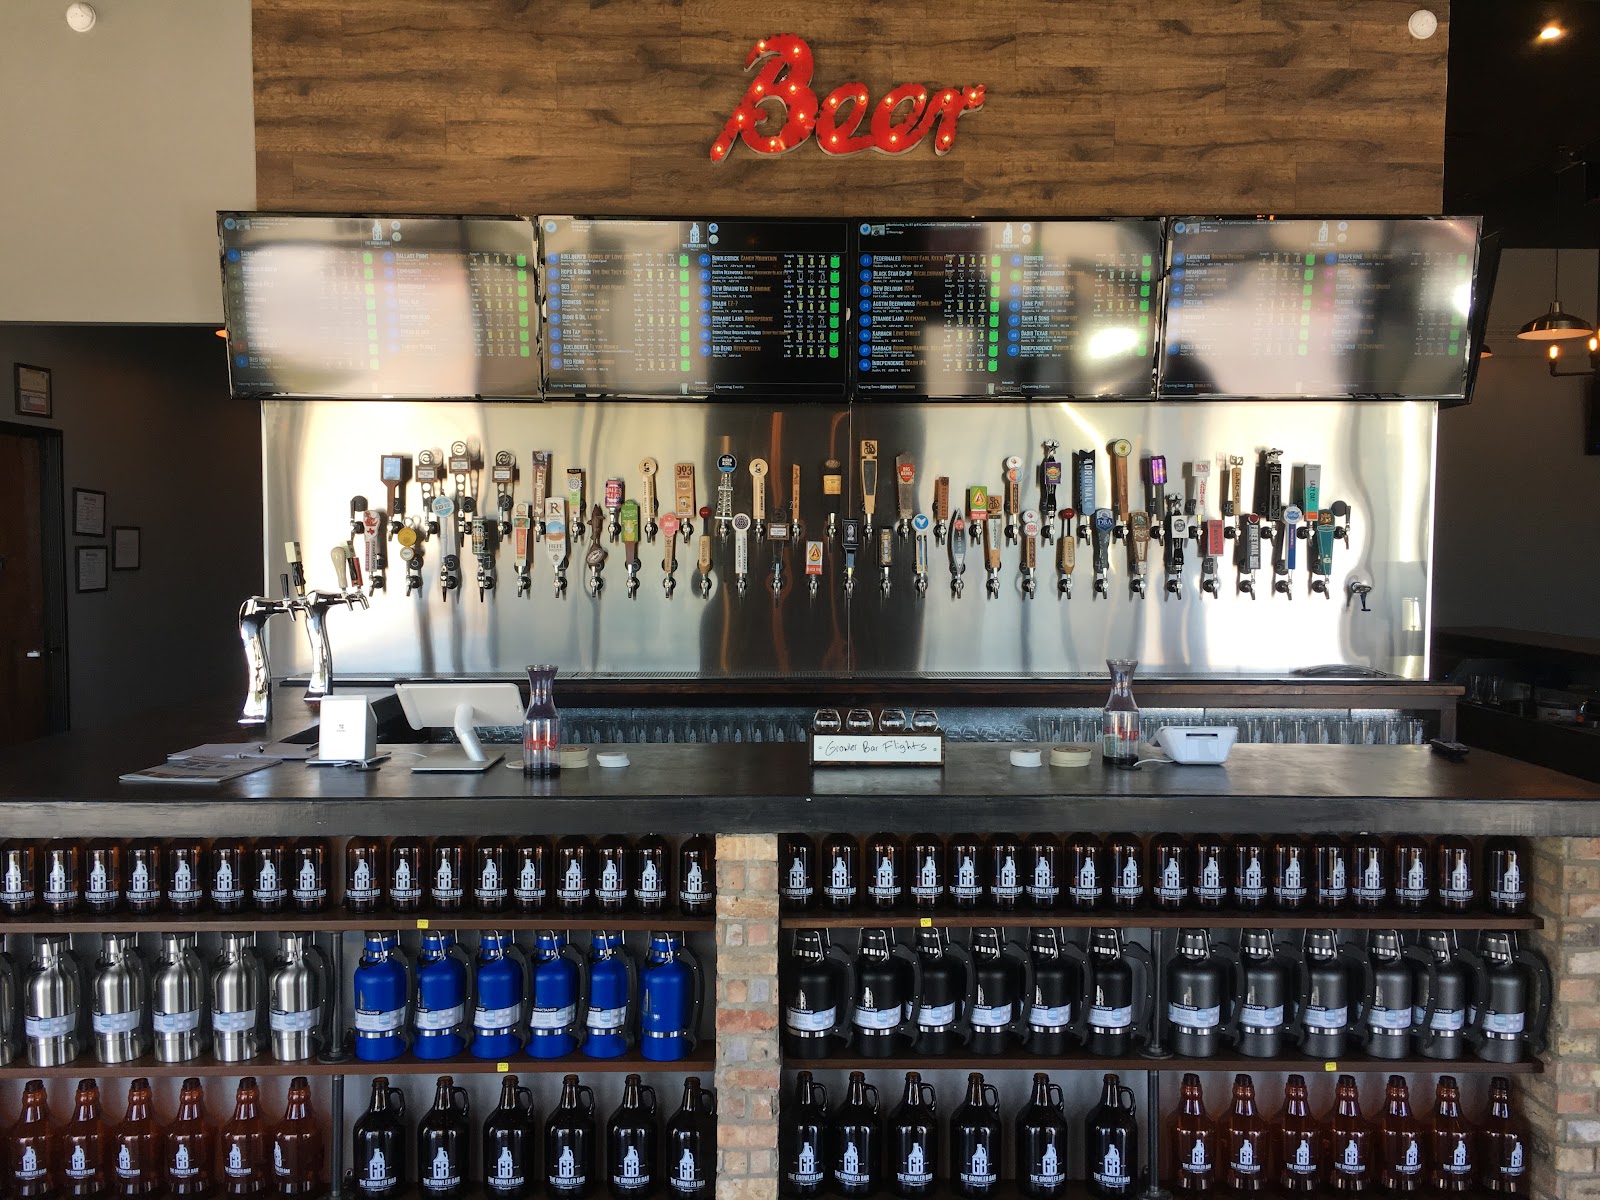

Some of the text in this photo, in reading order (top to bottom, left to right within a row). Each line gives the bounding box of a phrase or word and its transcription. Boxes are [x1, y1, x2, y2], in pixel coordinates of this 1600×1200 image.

[709, 33, 986, 163] Beer
[676, 465, 692, 476] 903
[1084, 464, 1093, 502] ORIGINAL
[550, 503, 560, 513] R
[525, 739, 557, 750] TIPS
[862, 740, 878, 758] Bar
[882, 740, 927, 758] Flights
[388, 1177, 397, 1185] BAR
[843, 1172, 860, 1181] GROWLER
[1102, 1174, 1121, 1182] GROWLER
